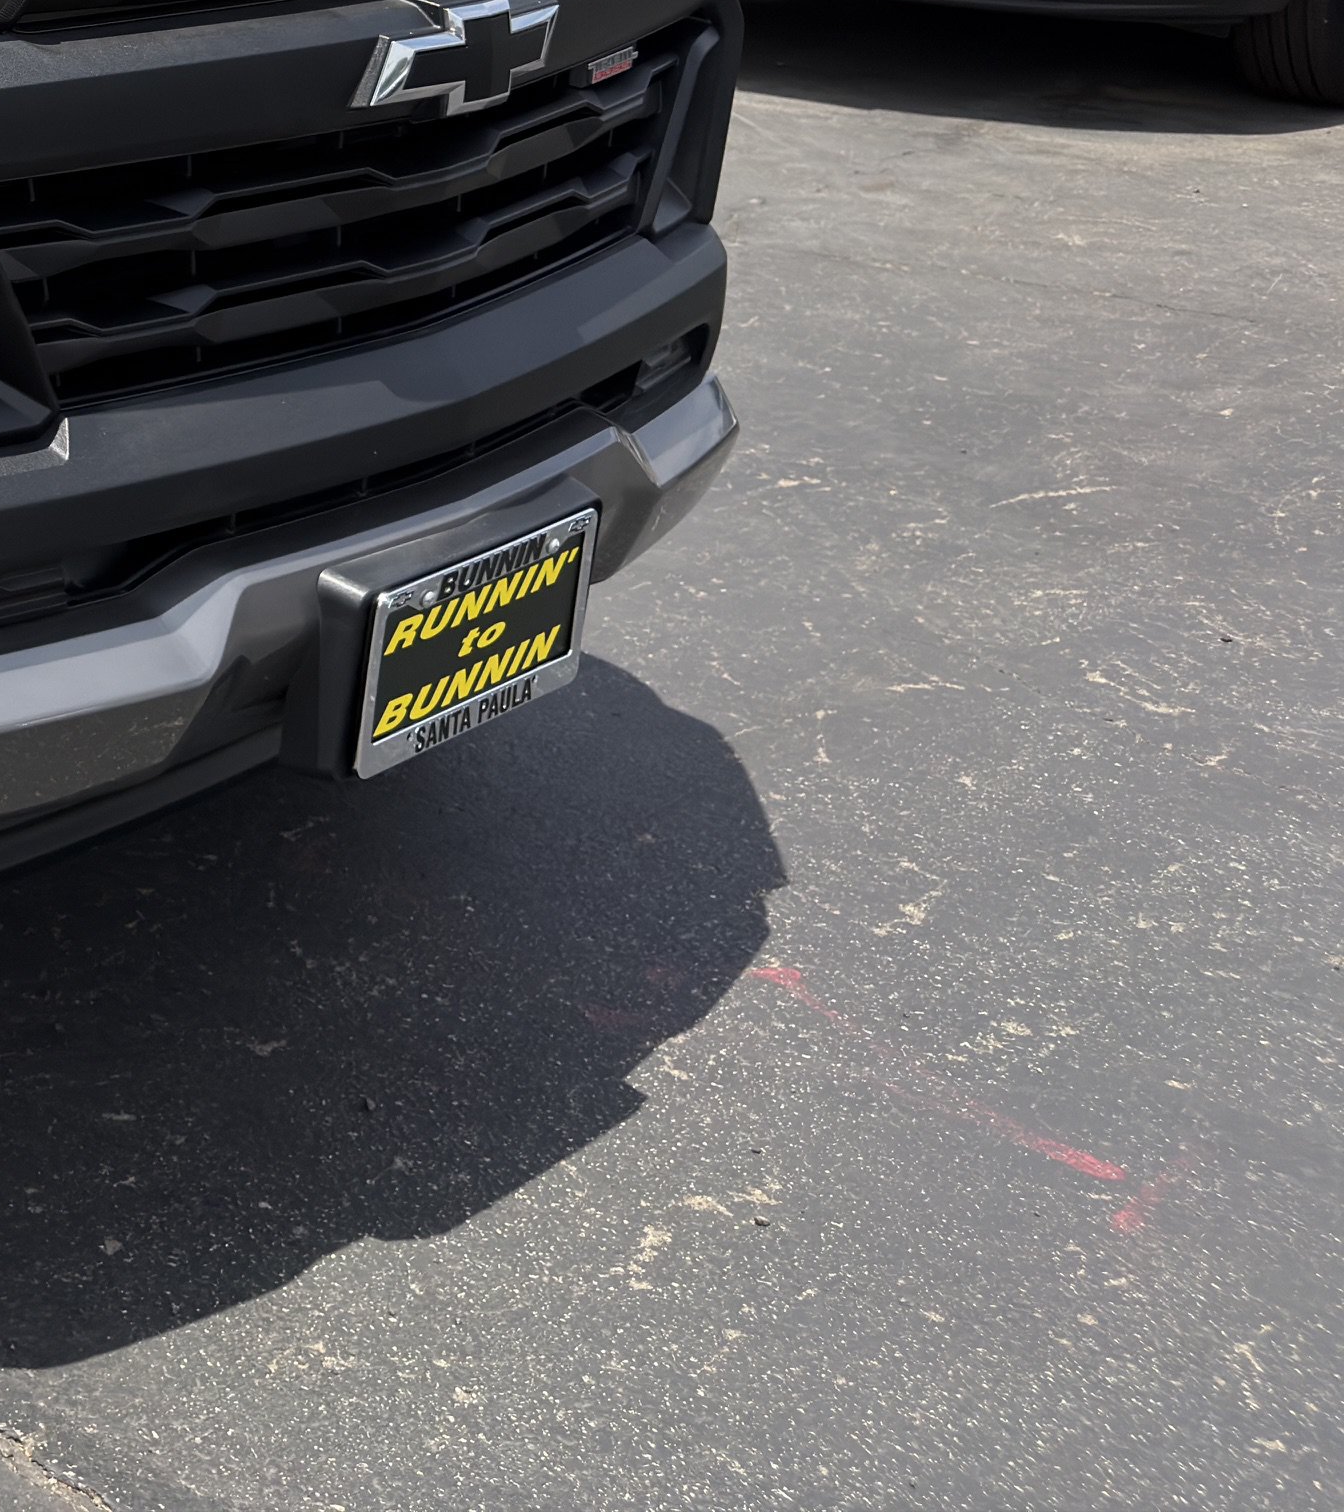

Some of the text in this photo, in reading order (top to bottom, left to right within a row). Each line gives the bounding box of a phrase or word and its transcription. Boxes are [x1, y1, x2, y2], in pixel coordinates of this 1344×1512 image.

[384, 547, 580, 657] RUNNIN'
[437, 534, 547, 602] BUNNIN
[458, 621, 506, 658] to
[373, 624, 561, 738] BUNNIN
[414, 679, 532, 753] SANTA PAULA
